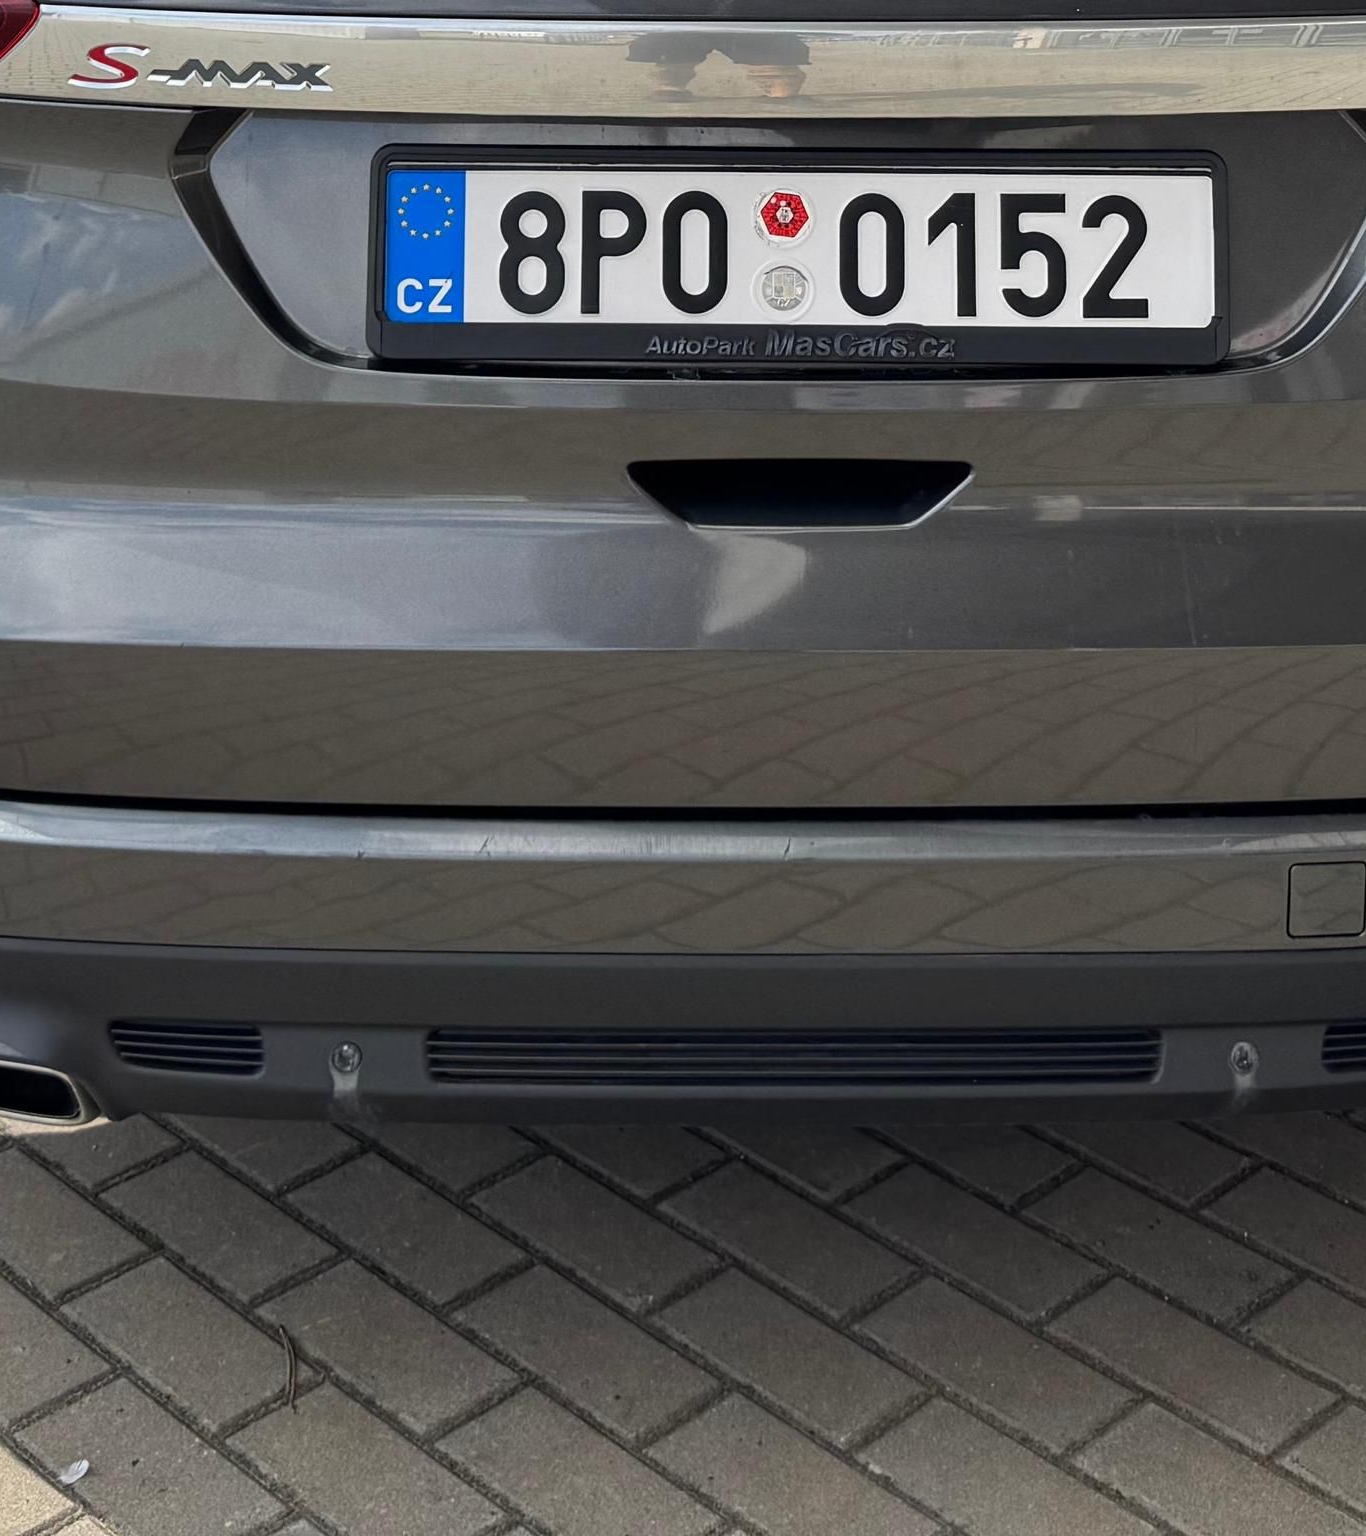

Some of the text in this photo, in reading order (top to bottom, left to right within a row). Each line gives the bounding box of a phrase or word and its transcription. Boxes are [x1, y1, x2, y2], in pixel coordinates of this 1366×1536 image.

[67, 42, 334, 92] S-MAX
[499, 190, 1149, 319] 8P0 0152
[397, 278, 453, 314] CZ
[645, 329, 956, 359] AutoPark MasCars.cz
